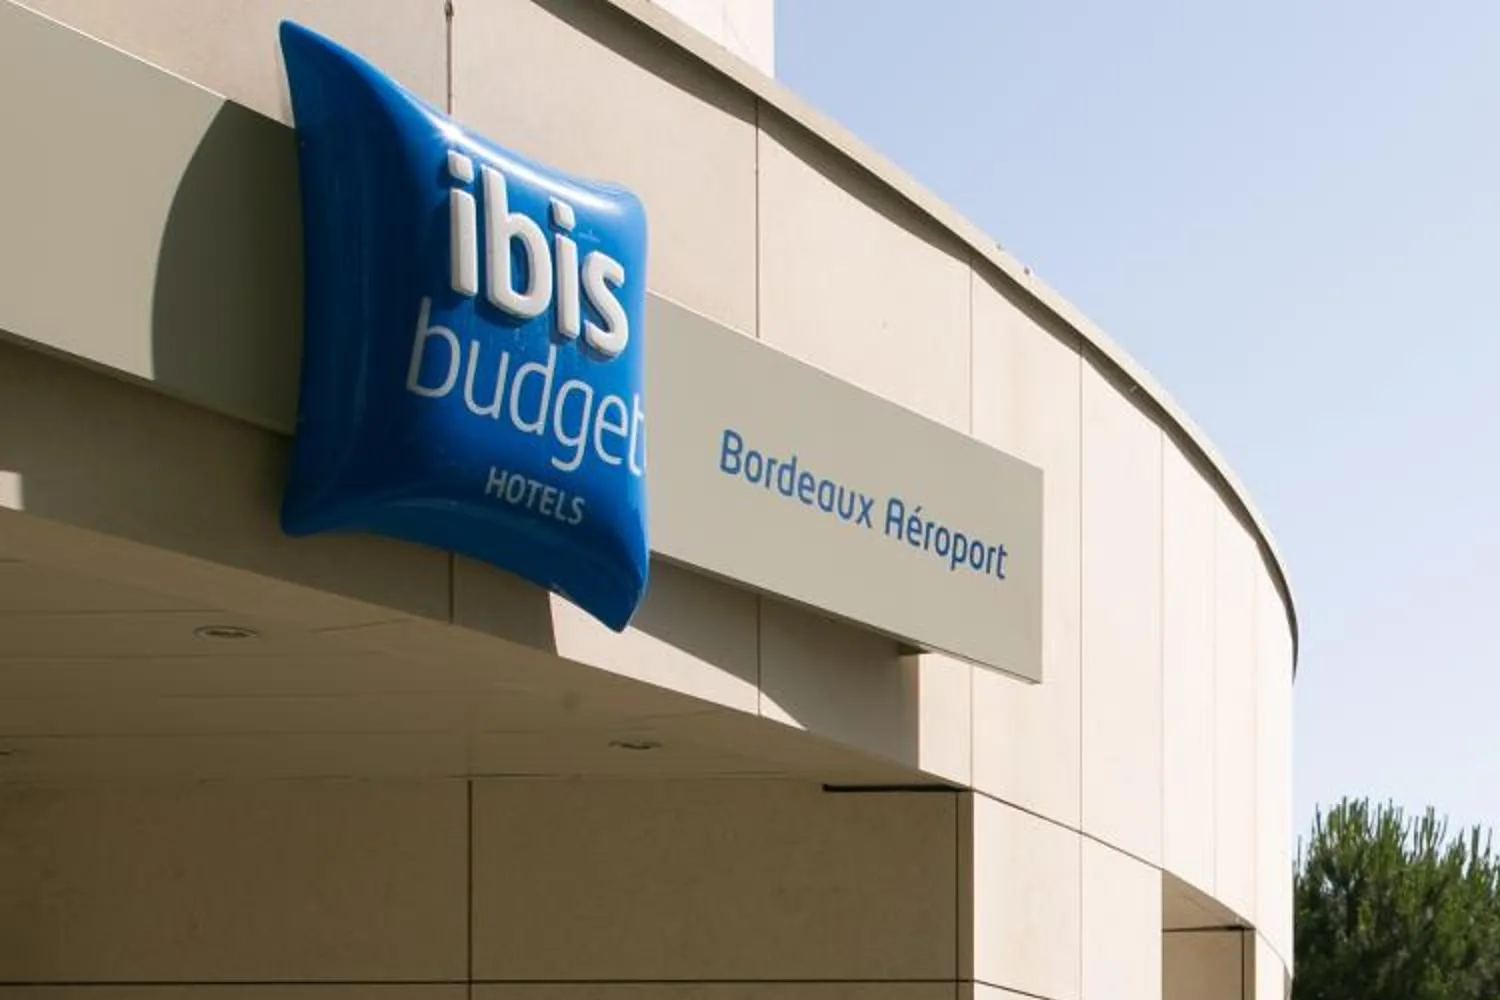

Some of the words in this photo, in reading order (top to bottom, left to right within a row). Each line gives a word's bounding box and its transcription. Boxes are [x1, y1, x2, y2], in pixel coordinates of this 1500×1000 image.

[448, 149, 629, 358] ibis
[406, 296, 647, 477] budget
[485, 465, 586, 525] HOTELS
[720, 429, 874, 529] Bordeaux
[884, 498, 1008, 580] Aéroport
